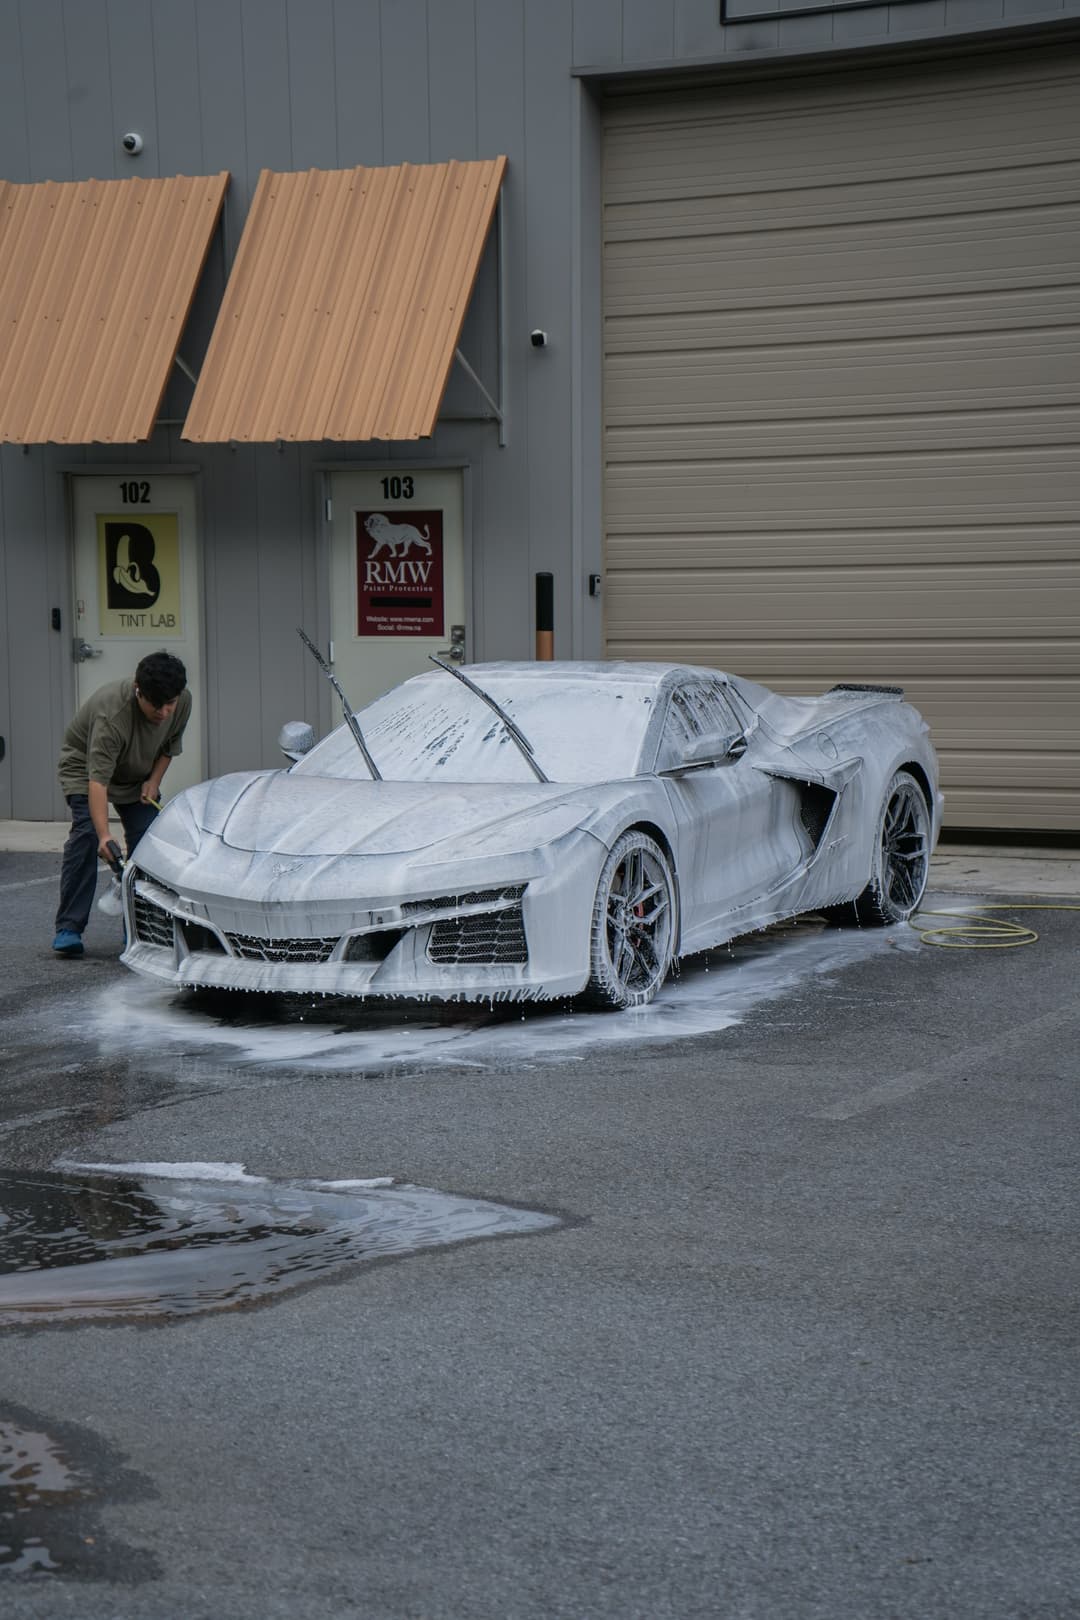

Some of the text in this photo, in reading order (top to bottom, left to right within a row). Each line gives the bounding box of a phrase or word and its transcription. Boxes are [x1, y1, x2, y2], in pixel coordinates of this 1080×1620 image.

[119, 481, 151, 504] 102
[380, 476, 414, 499] 103
[104, 522, 161, 610] B
[364, 561, 433, 584] RMW
[118, 614, 176, 627] TINT LAB
